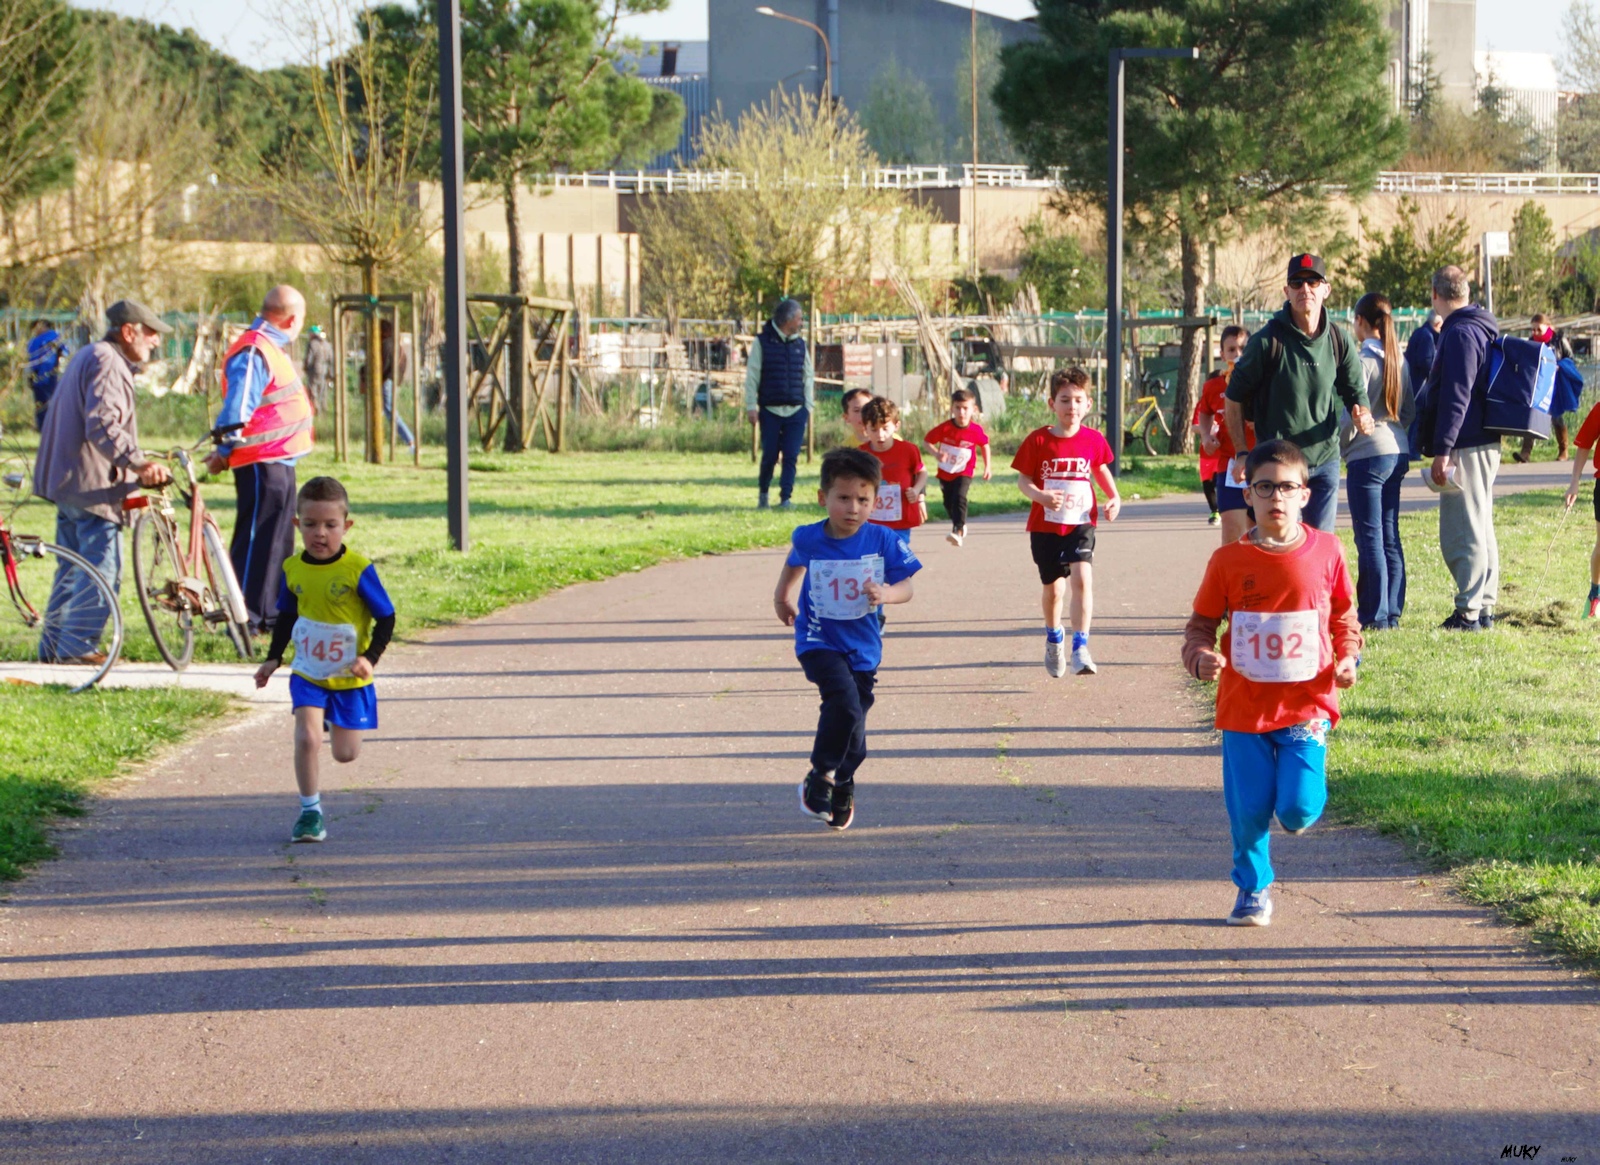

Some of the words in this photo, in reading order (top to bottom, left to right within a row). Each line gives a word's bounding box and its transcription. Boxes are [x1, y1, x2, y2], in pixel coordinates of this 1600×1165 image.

[876, 496, 894, 510] 32
[1064, 494, 1084, 510] 54
[828, 577, 872, 601] 13
[301, 636, 344, 663] 145
[1248, 633, 1303, 660] 192
